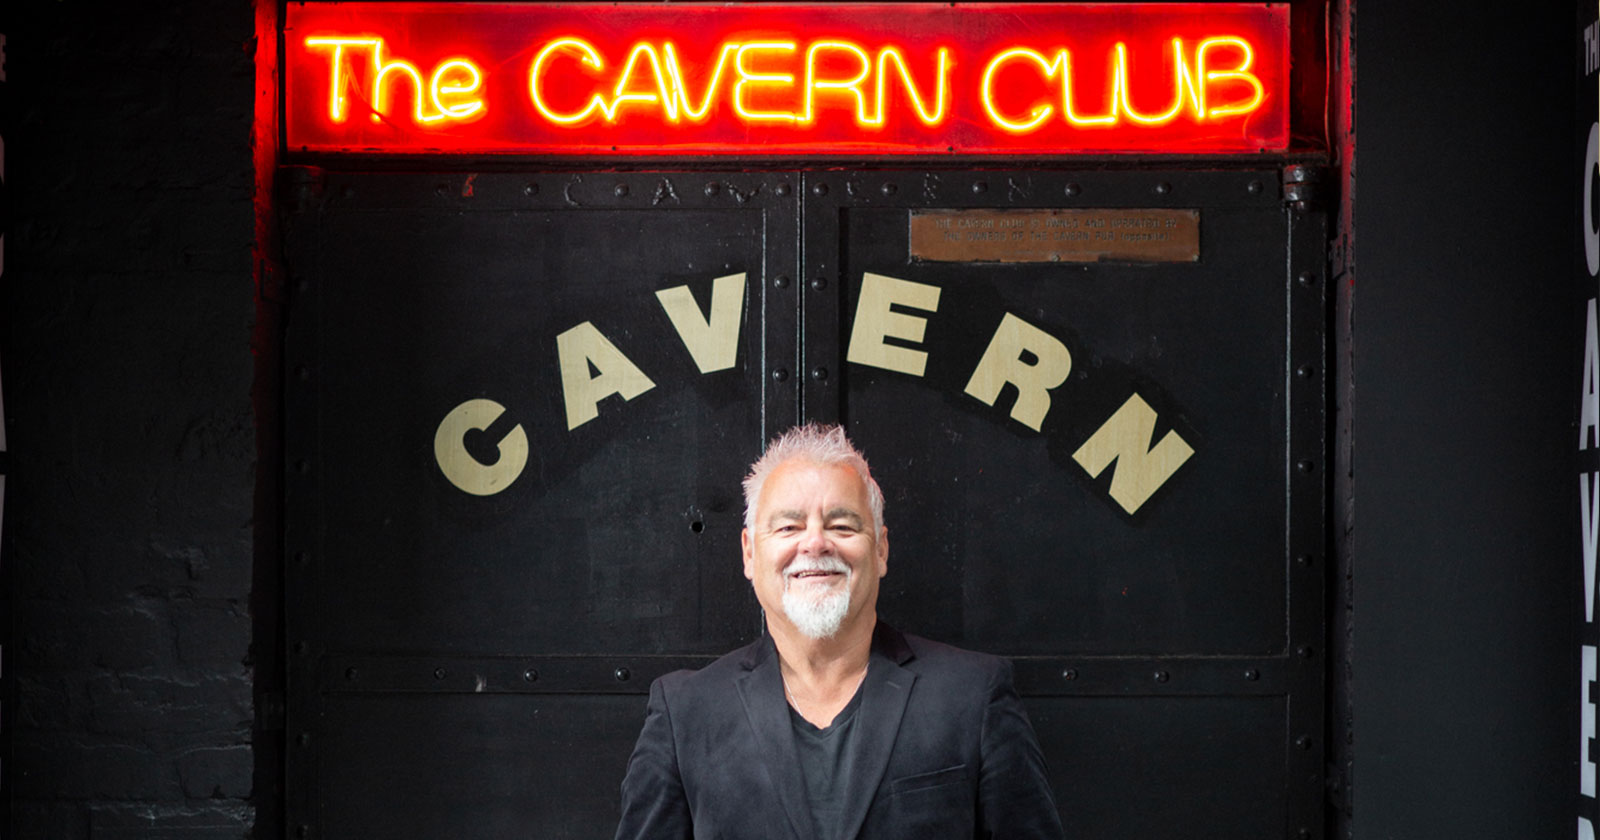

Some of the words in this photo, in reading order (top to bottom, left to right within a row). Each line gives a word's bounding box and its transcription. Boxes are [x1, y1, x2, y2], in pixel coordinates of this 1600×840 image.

[306, 37, 483, 122] The
[530, 38, 949, 126] CAVERN
[982, 35, 1264, 131] CLUB
[1584, 17, 1599, 76] TH
[935, 218, 952, 229] THE
[1084, 218, 1105, 229] AND
[943, 231, 960, 241] THE
[967, 231, 1006, 241] OWNERS
[1012, 231, 1024, 241] OF
[1031, 231, 1047, 241] THE
[1053, 231, 1090, 241] CAVERN
[1095, 231, 1115, 241] PUB
[434, 272, 1195, 515] CAVERN
[1578, 121, 1599, 840] CAVE
